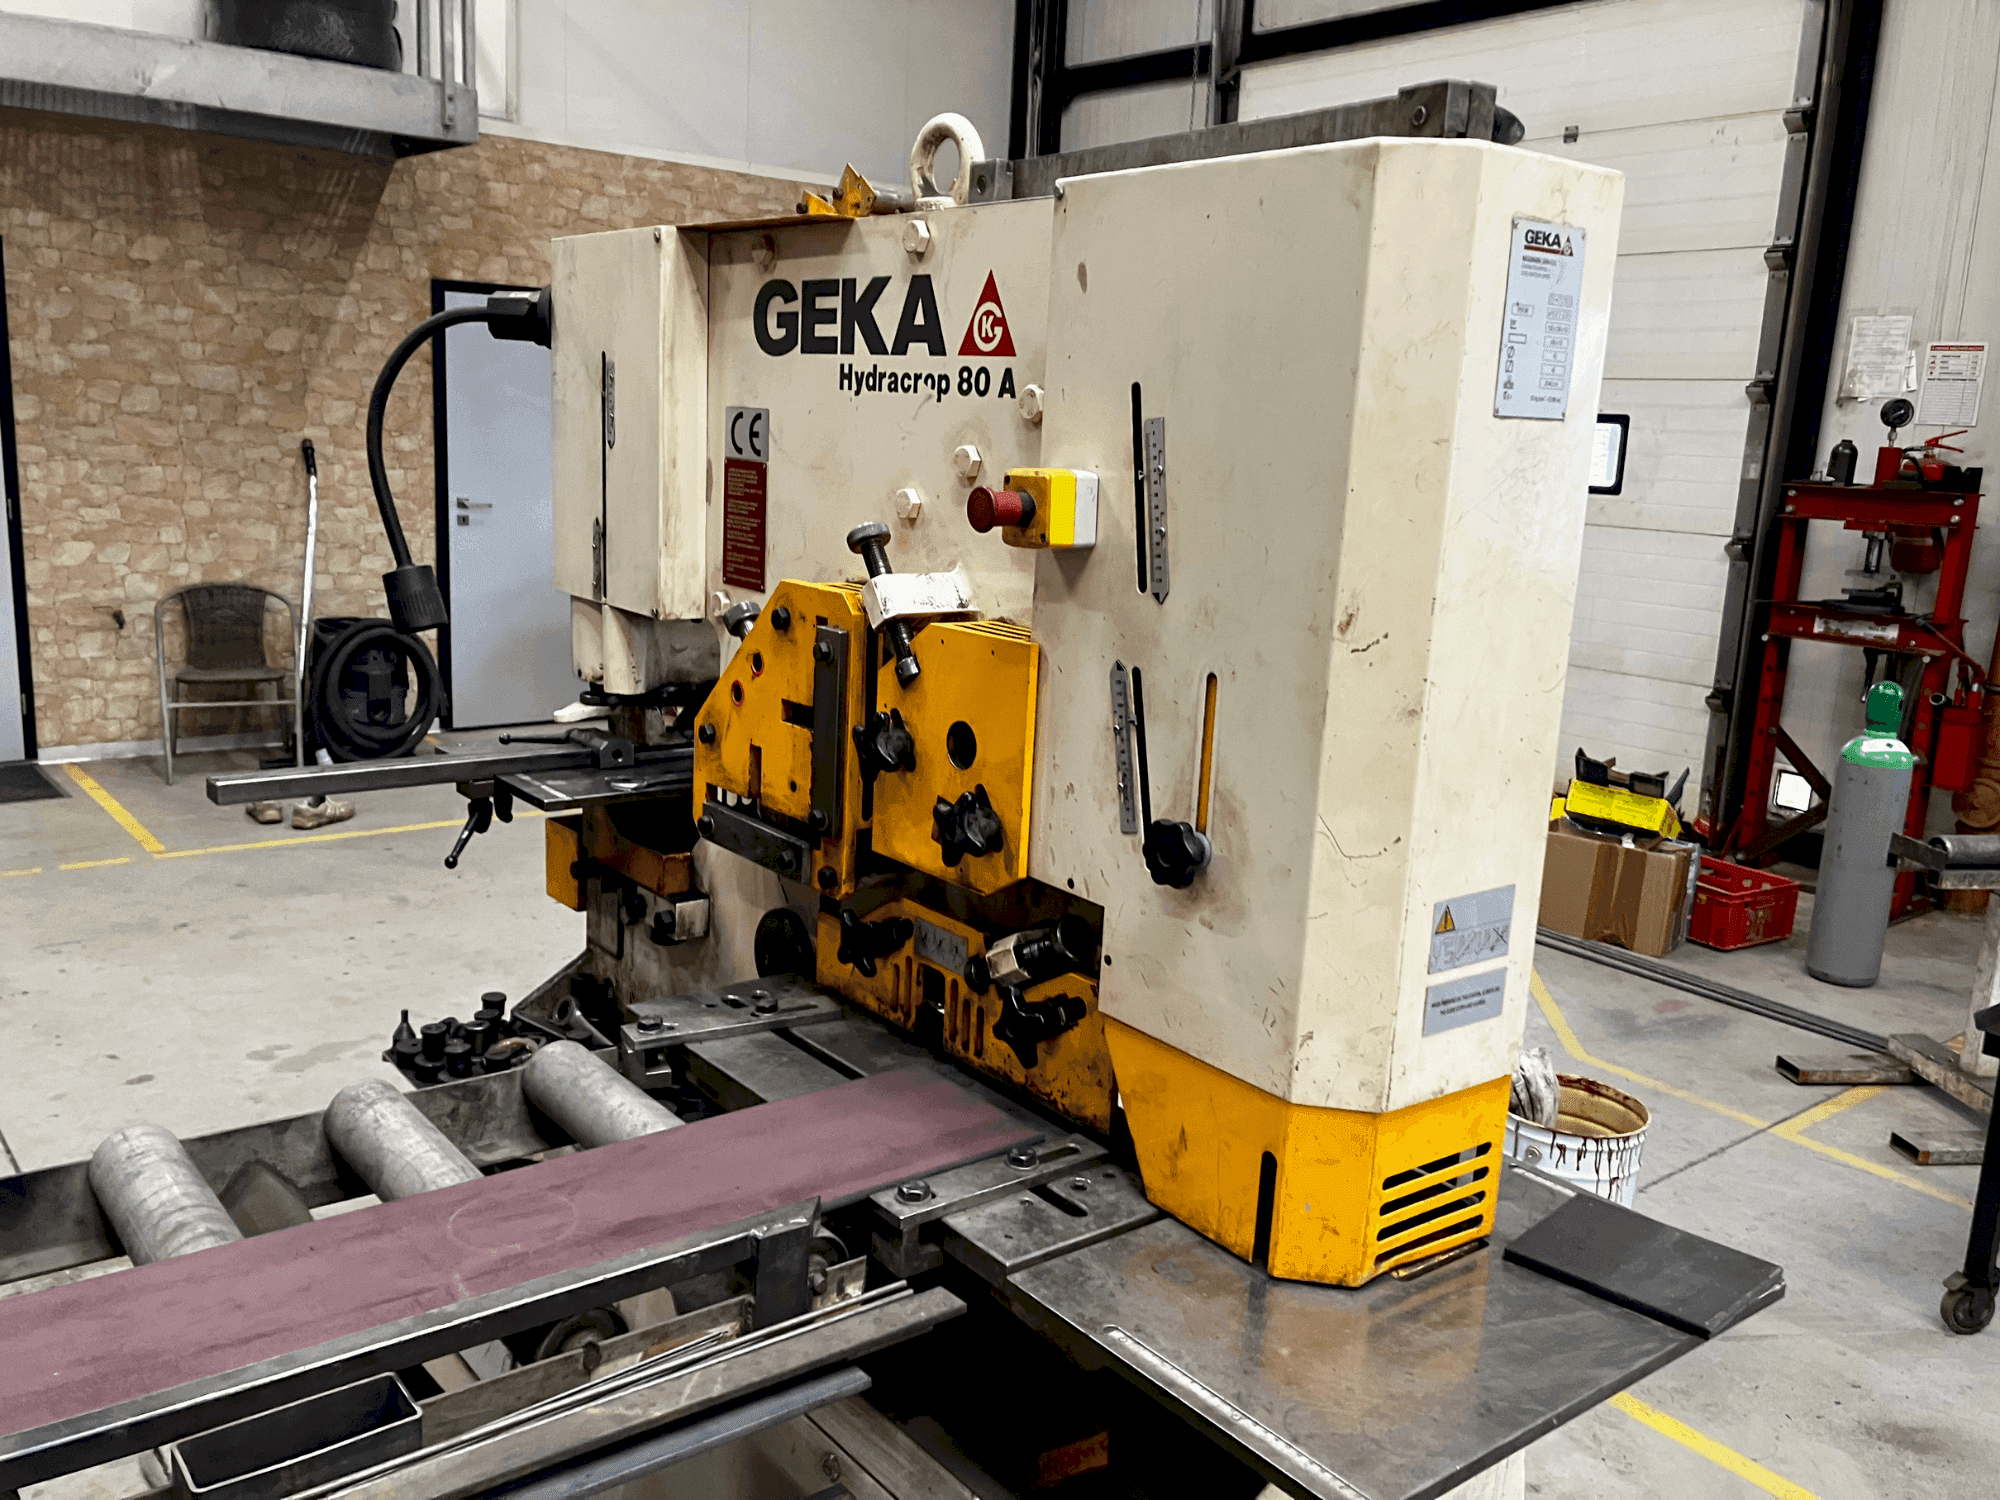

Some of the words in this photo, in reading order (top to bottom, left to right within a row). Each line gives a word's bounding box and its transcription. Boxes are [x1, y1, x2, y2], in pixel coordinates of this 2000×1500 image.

[1524, 229, 1561, 248] GEKA
[753, 273, 947, 357] GEKA
[839, 363, 951, 403] Hydracrop
[957, 365, 991, 397] 80
[997, 367, 1017, 399] A
[730, 411, 762, 456] CE
